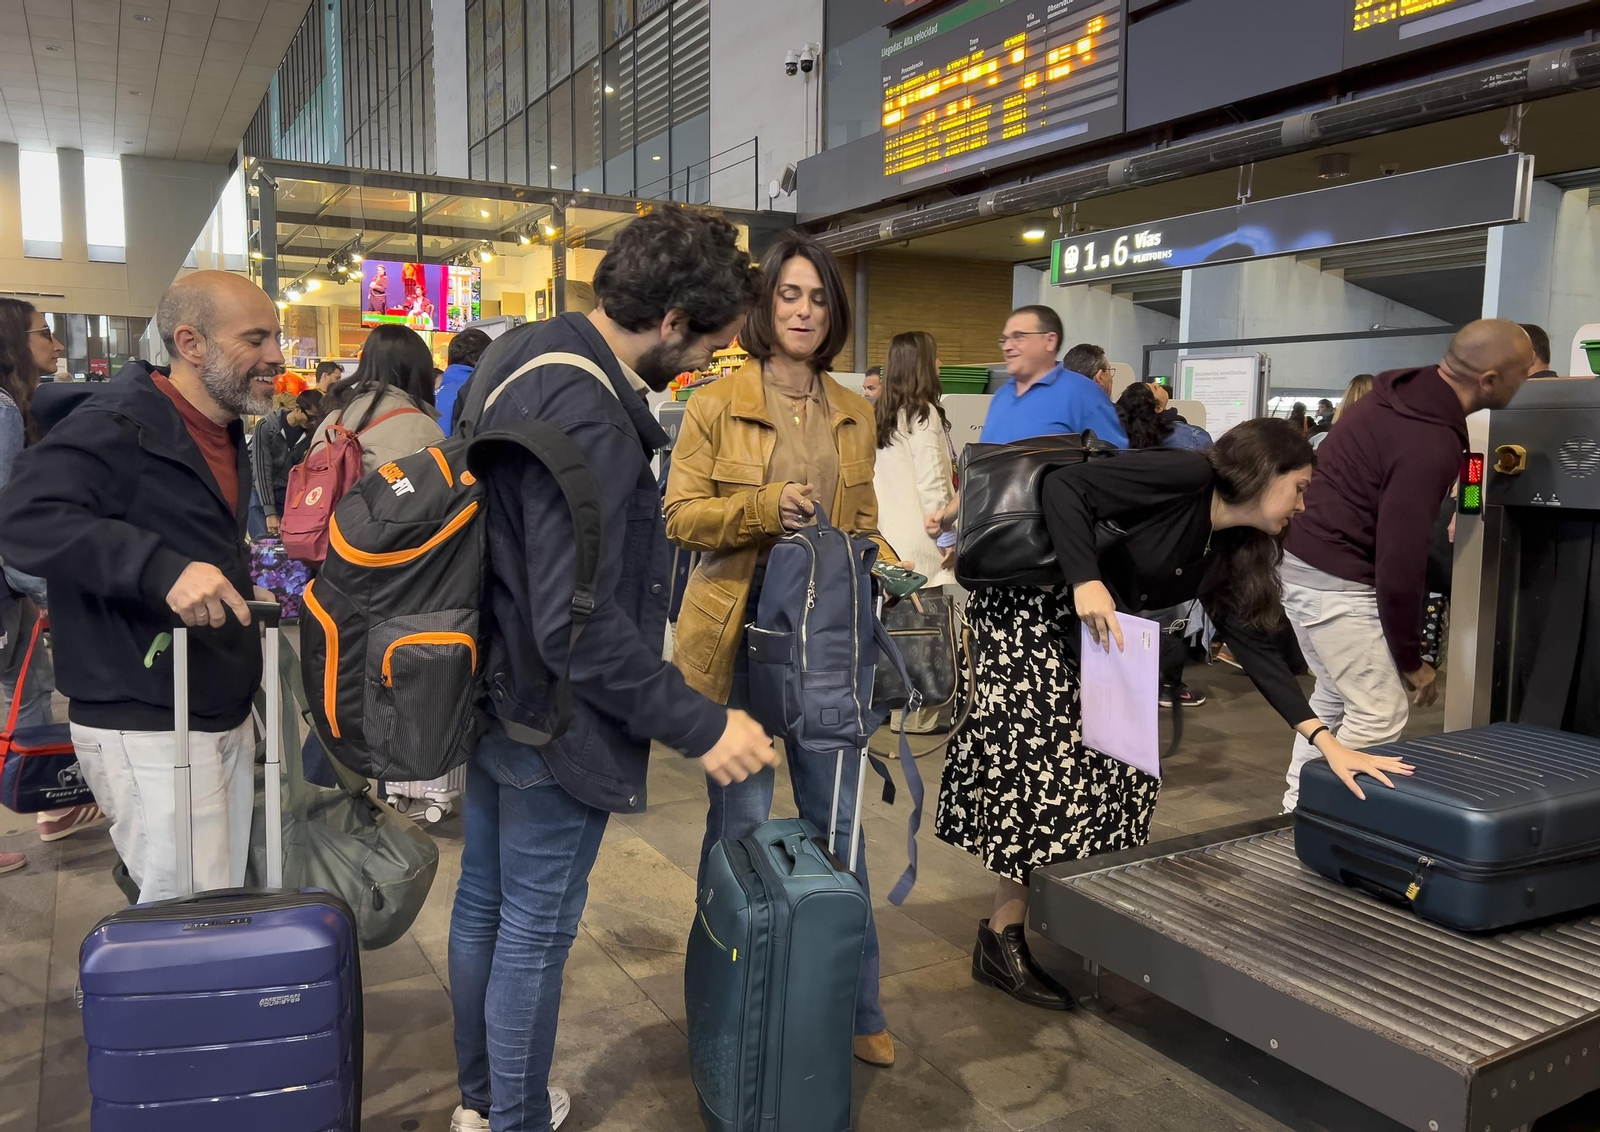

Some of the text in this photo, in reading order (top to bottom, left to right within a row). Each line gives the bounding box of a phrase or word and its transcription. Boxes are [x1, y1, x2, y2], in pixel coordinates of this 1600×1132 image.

[881, 22, 938, 58] Llegadas: Alta velocidad
[1113, 235, 1129, 266] 6
[1134, 230, 1162, 249] Vías
[1133, 249, 1173, 264] PLATFORMS
